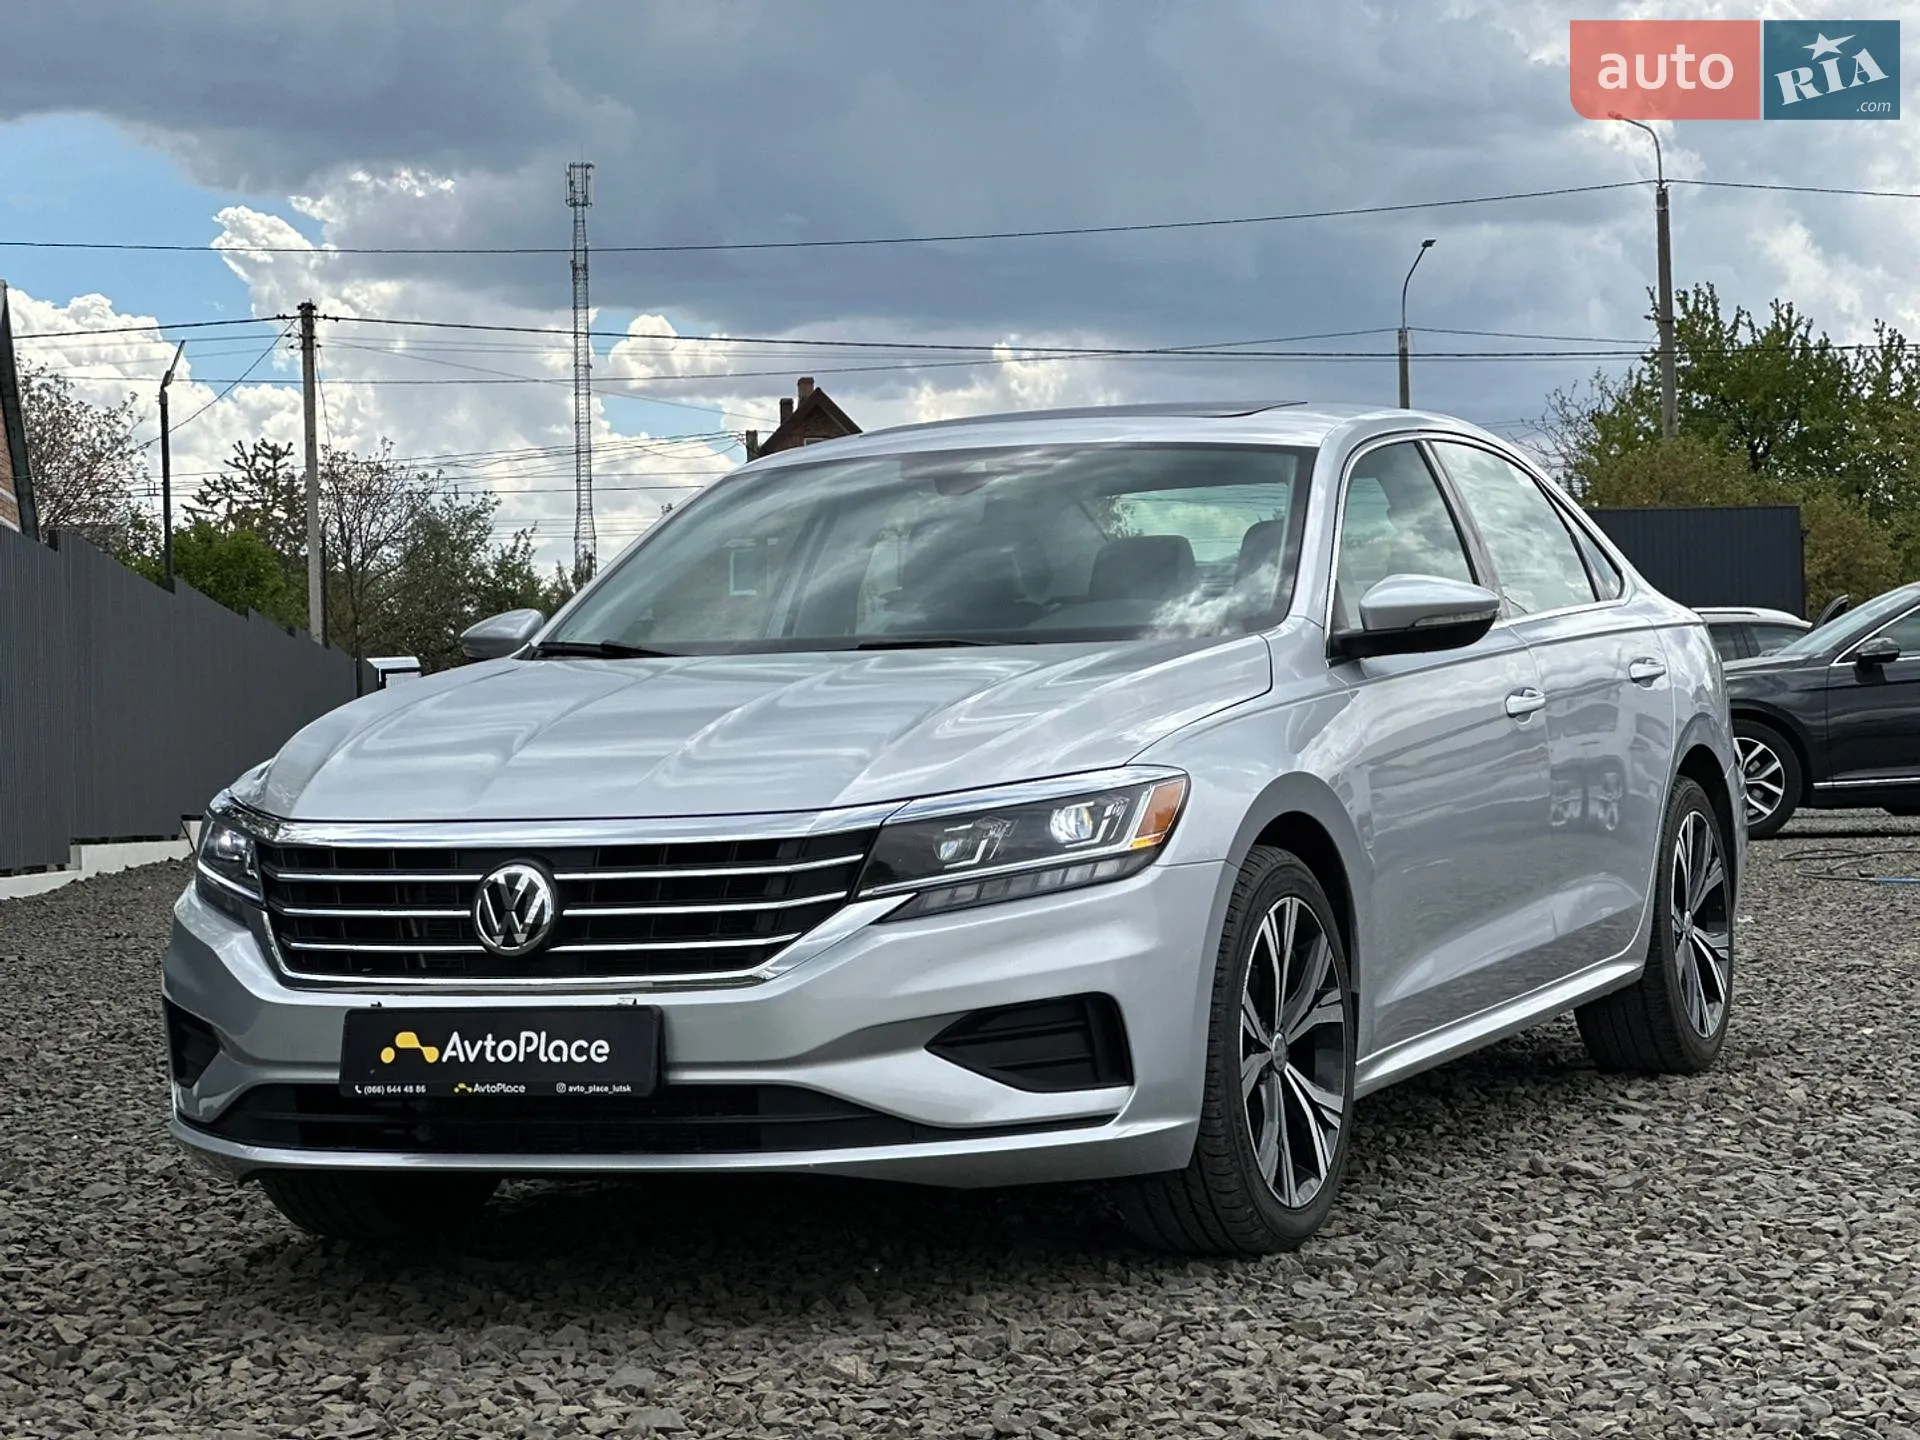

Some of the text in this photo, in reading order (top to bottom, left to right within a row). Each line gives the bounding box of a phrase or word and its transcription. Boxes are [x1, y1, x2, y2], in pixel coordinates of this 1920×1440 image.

[441, 1030, 610, 1064] AvtoPlace
[386, 1084, 401, 1094] 644
[473, 1082, 526, 1094] AvtoPlace
